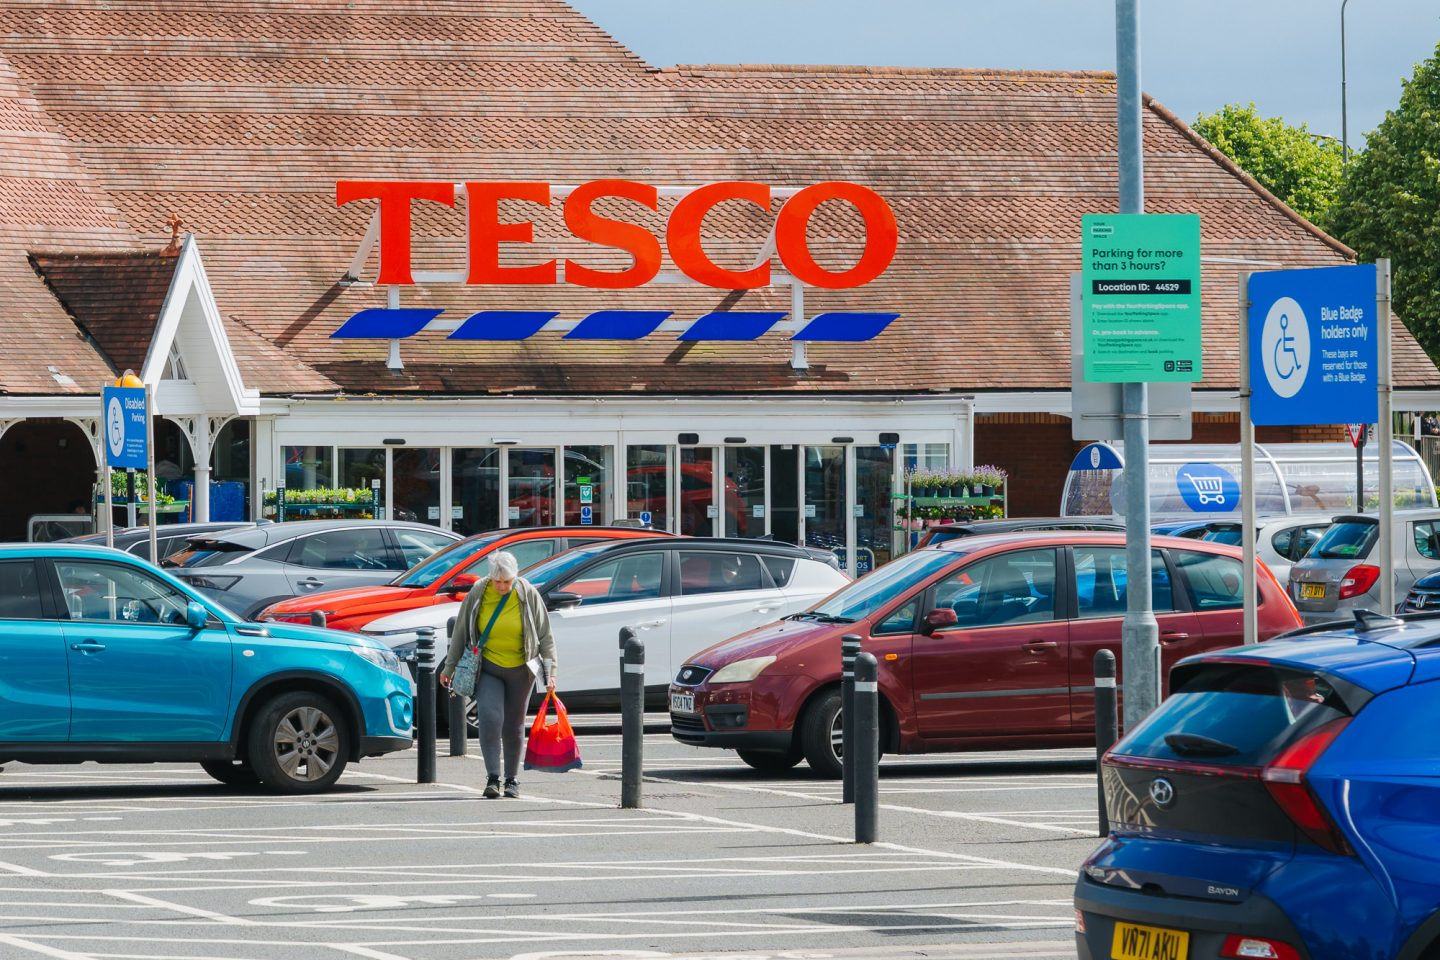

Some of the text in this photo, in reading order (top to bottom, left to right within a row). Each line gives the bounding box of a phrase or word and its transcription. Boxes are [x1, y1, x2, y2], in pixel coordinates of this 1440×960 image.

[335, 179, 898, 290] TESCO
[1092, 248, 1183, 260] Parking for more
[1092, 261, 1166, 270] than 3 hours?
[1098, 283, 1137, 291] Location
[1321, 306, 1363, 322] Blue Badge
[1322, 323, 1368, 341] holders only
[1322, 350, 1336, 358] These
[1338, 349, 1348, 360] bays
[1322, 362, 1344, 370] reserved
[1354, 361, 1367, 369] those
[1323, 373, 1333, 382] with
[1339, 372, 1349, 381] Blue
[125, 397, 145, 410] Disabled
[132, 413, 145, 424] Parking
[1208, 886, 1239, 896] BAYON
[1122, 927, 1180, 960] VN71 AKU
